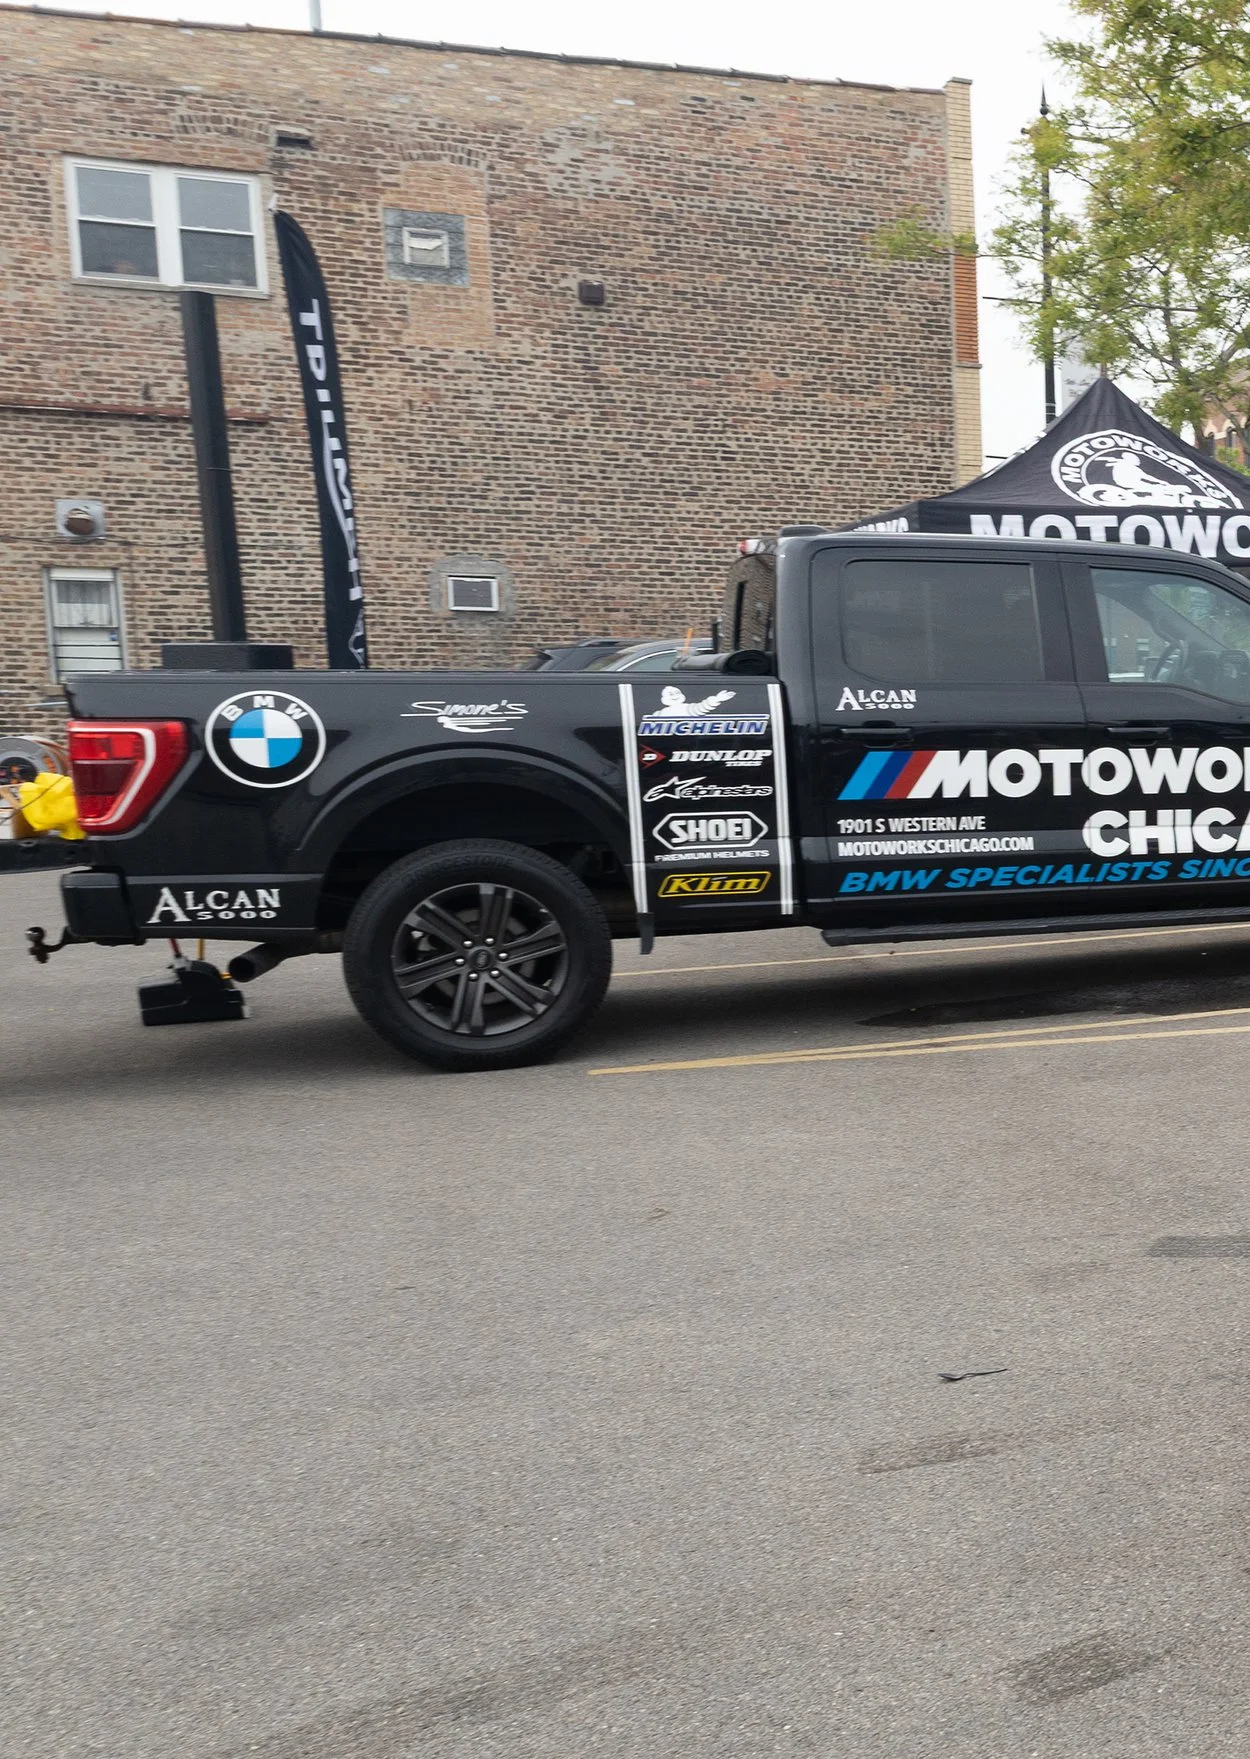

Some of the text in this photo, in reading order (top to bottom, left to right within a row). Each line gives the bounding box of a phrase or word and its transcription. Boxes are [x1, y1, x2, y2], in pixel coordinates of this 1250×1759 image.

[1060, 437, 1227, 500] MOTOWORKS
[220, 695, 308, 721] BMW
[835, 687, 917, 710] ALCAN
[638, 721, 768, 736] MICHELIN
[669, 750, 772, 762] DUNLOP
[669, 818, 752, 843] SHOEI
[837, 816, 986, 833] 1901 S WESTERN AVE
[655, 850, 770, 862] PREMIUM HELMETS
[838, 837, 1034, 857] MOTOWORKSCHICAGO.COM
[839, 869, 944, 893] BMW
[945, 861, 1172, 888] SPECIALISTS
[146, 887, 281, 923] ALCAN
[196, 910, 277, 920] 5000
